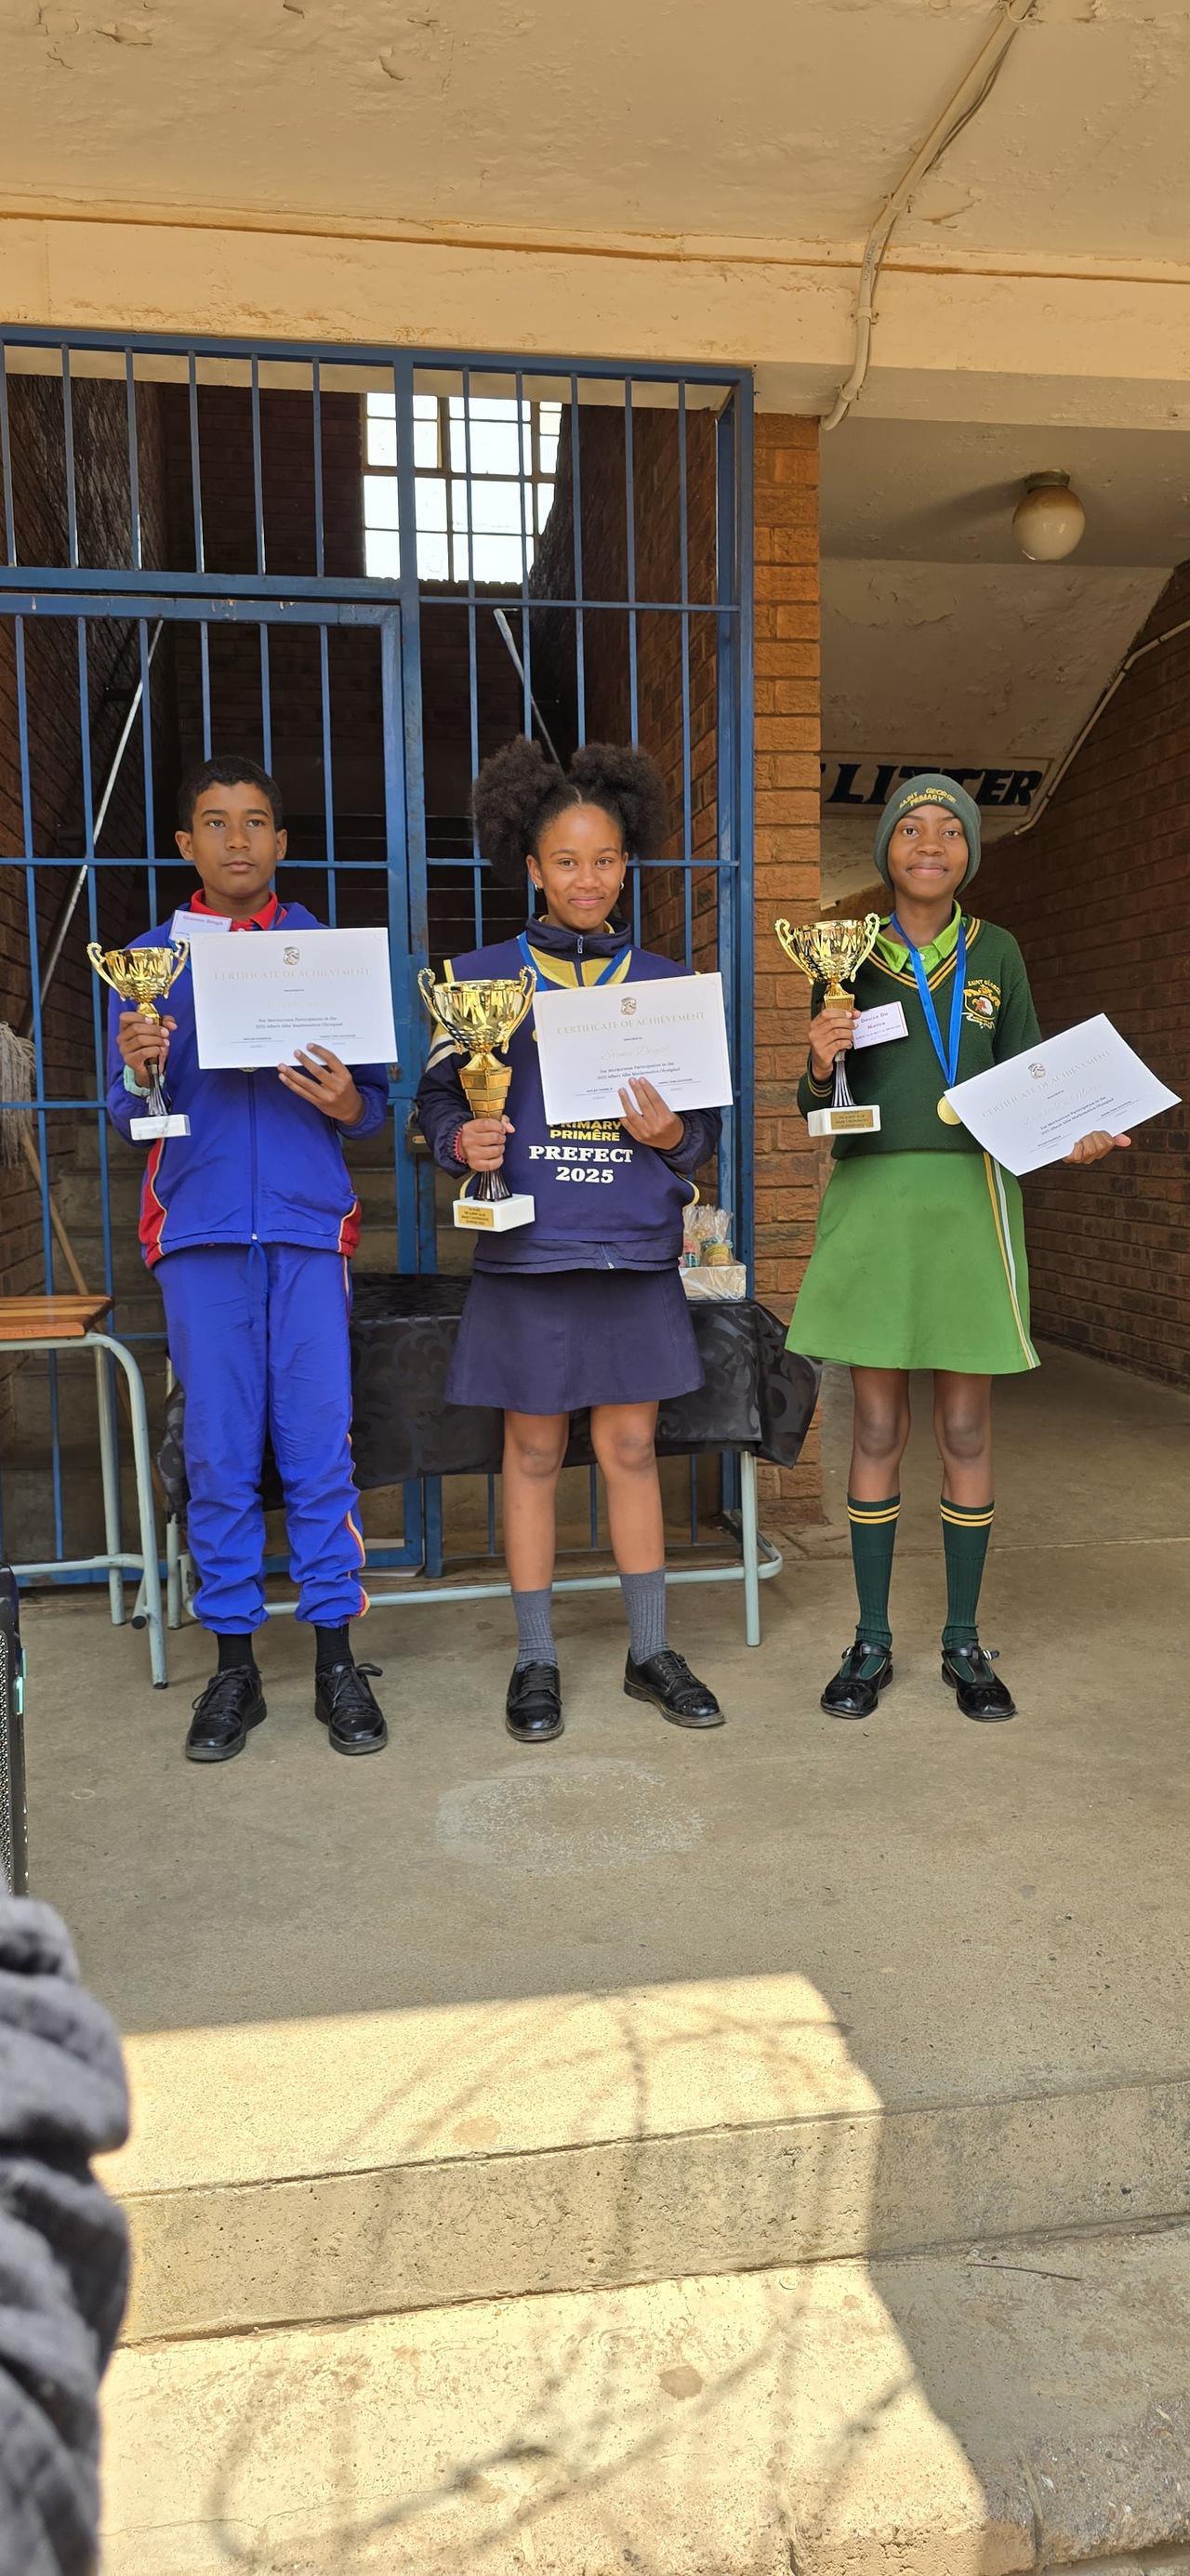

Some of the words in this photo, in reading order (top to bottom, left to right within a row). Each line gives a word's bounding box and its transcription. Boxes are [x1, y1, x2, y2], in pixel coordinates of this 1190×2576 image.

[910, 794, 944, 806] PRIMARY
[558, 1020, 618, 1036] CERTIFICATE
[620, 1019, 633, 1028] OF
[637, 1011, 707, 1026] ACHIEVEMENT
[549, 1129, 621, 1142] PRIMÊRE
[528, 1145, 633, 1163] PREFECT
[555, 1167, 615, 1183] 2025
